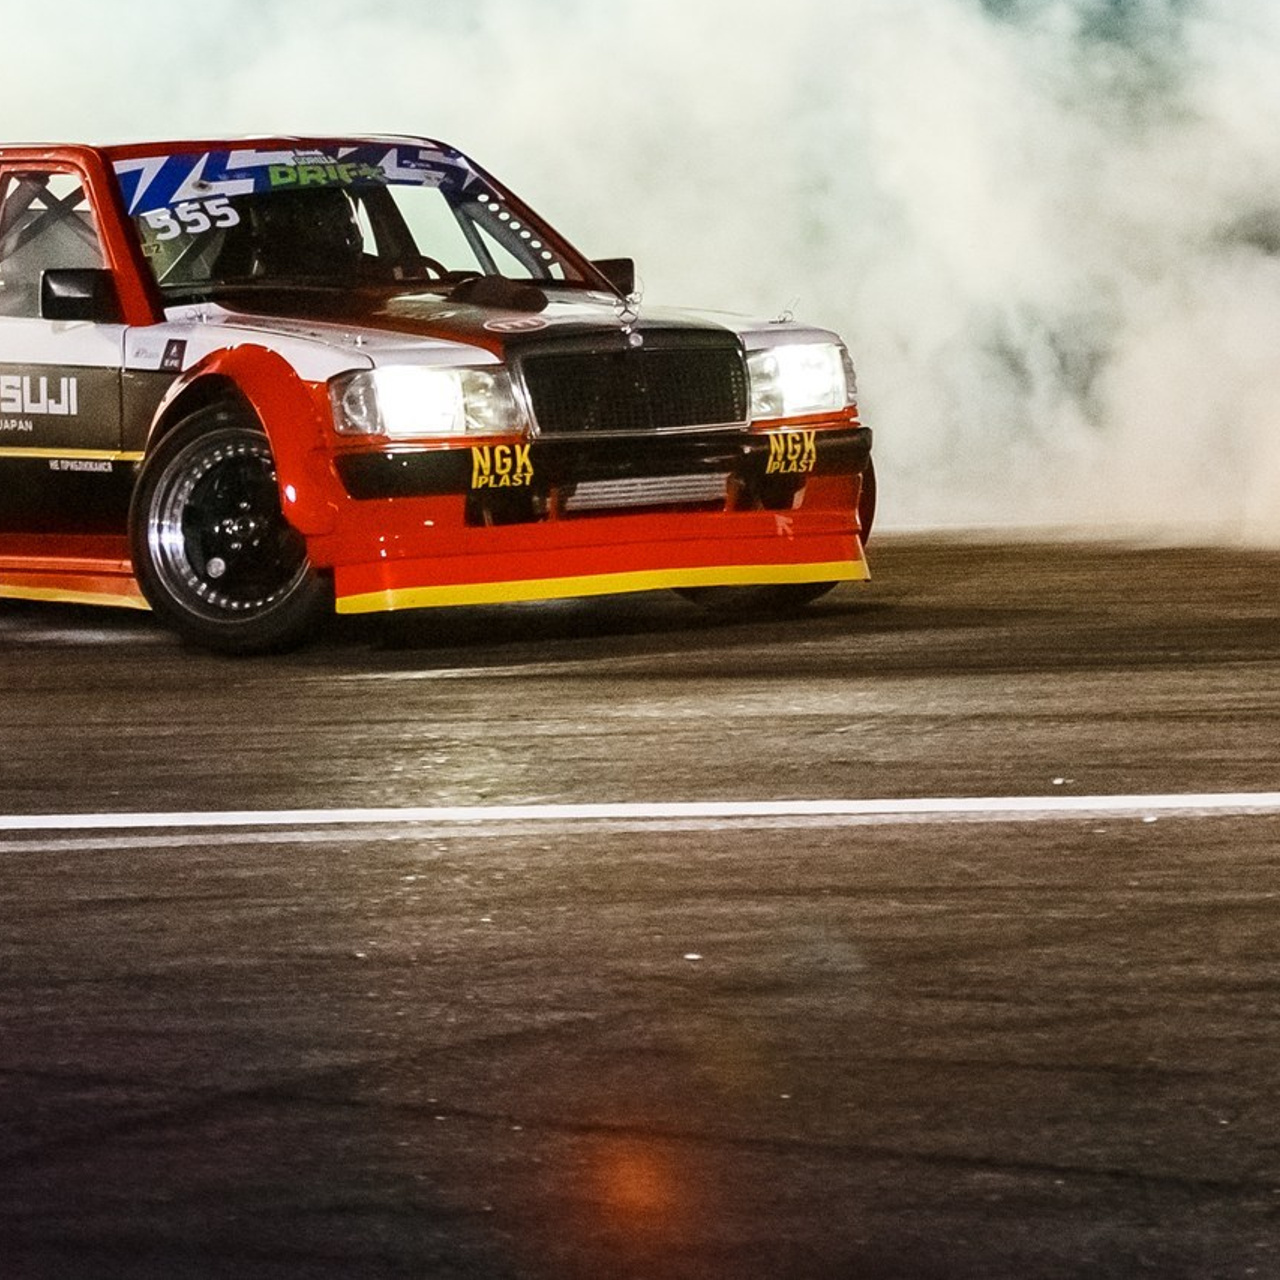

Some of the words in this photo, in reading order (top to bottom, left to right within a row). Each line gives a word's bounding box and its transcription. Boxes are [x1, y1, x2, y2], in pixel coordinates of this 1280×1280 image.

[140, 197, 241, 241] 555
[472, 439, 534, 480] NGK
[767, 430, 817, 467] NGK
[772, 459, 815, 474] PLAST
[477, 472, 534, 489] PLAST
